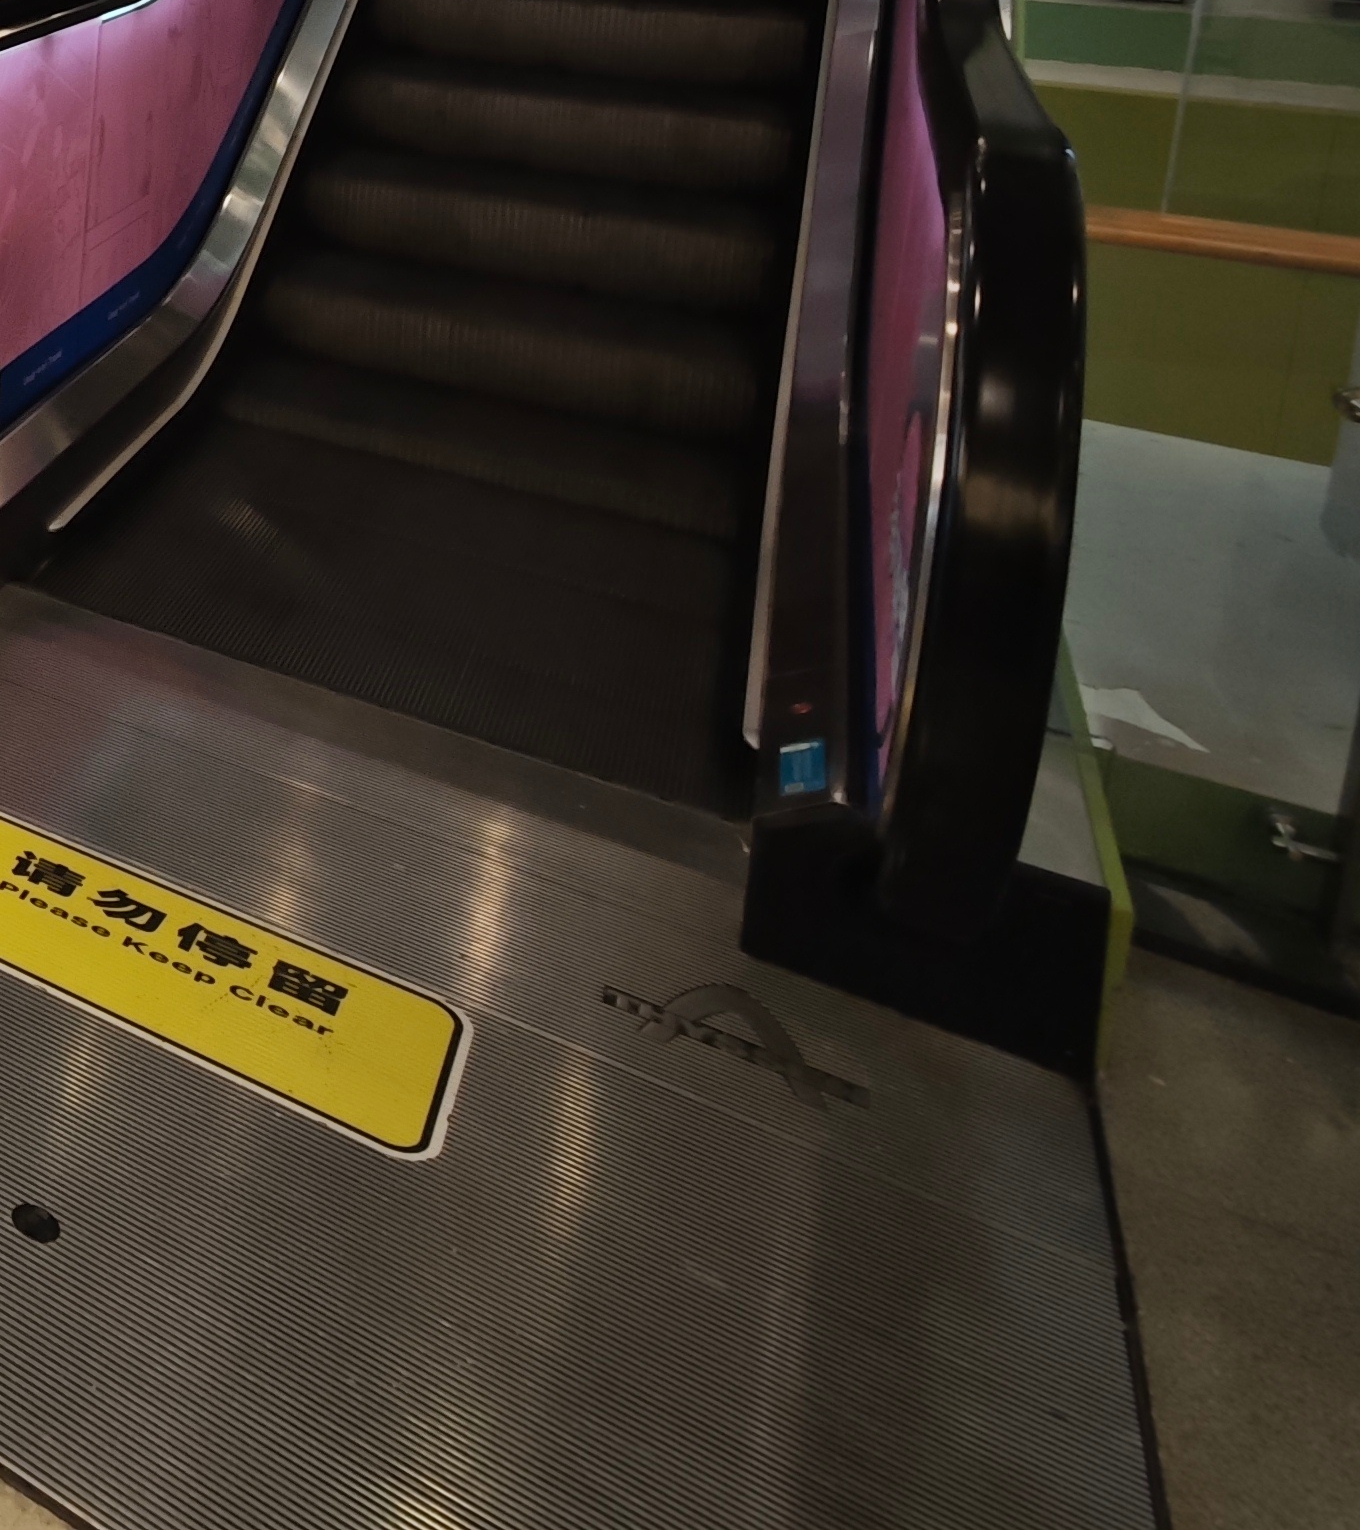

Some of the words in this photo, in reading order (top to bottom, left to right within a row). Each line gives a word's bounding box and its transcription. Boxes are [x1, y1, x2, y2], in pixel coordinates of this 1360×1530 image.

[12, 850, 349, 1018] 请勿停留
[122, 935, 216, 986] Keep
[229, 983, 334, 1037] Clear
